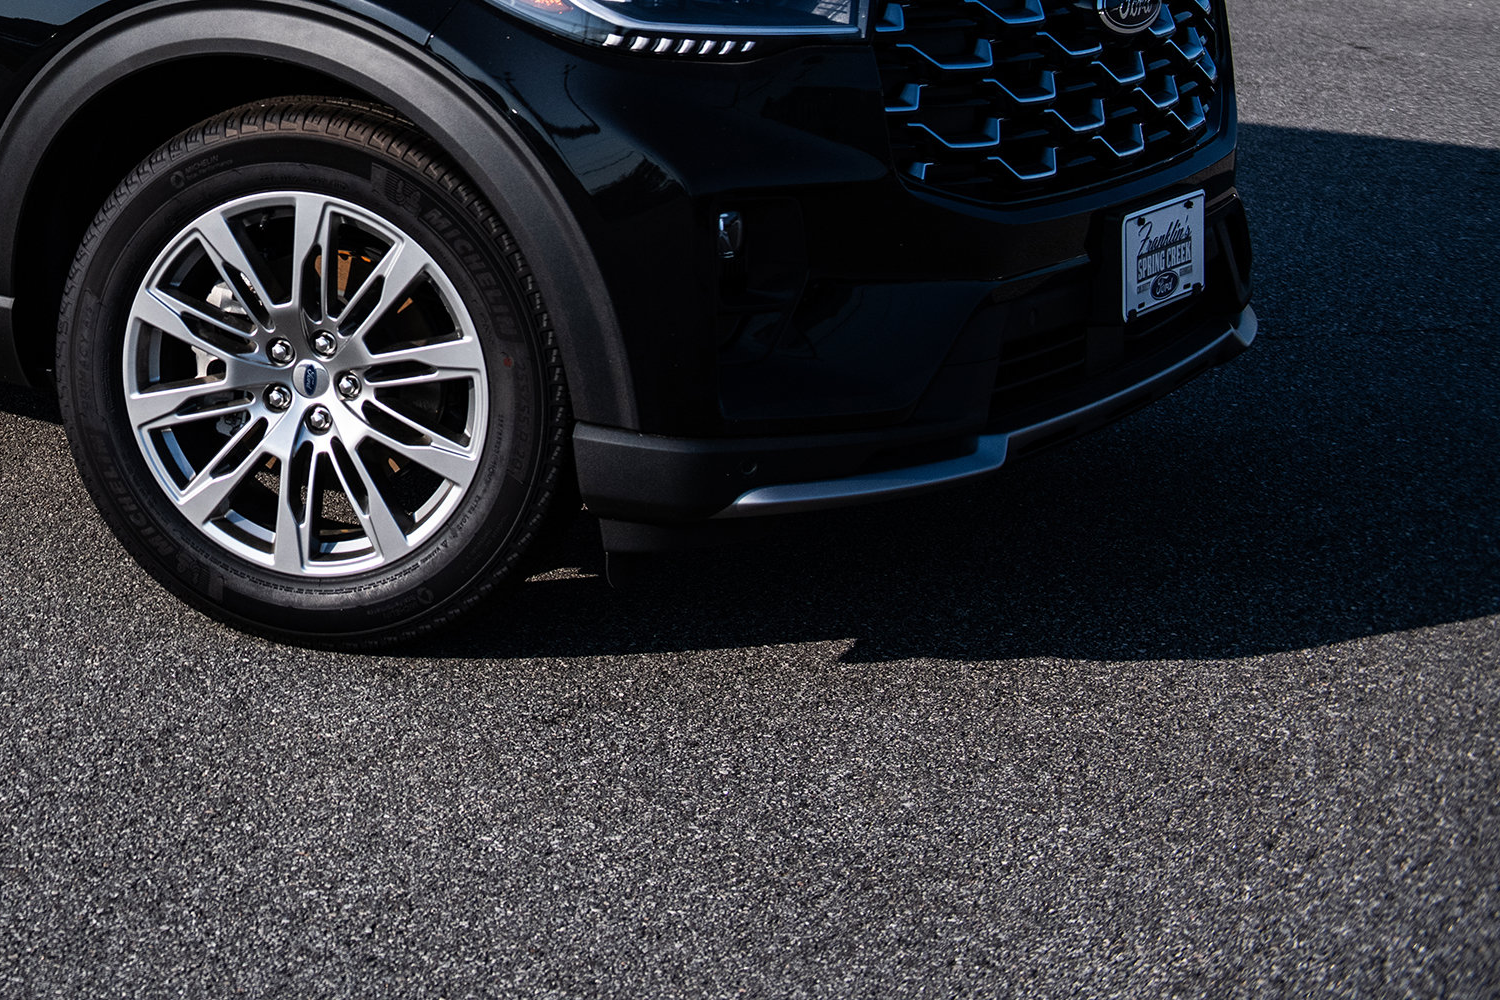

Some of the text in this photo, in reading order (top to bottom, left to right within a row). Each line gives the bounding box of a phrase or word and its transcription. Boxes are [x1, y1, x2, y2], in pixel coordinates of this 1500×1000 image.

[1137, 214, 1193, 256] Franklin's
[424, 208, 518, 335] MICHELIN
[1137, 241, 1192, 281] SPRING CREEK
[1155, 275, 1174, 296] Ford
[90, 434, 174, 557] MICHELIN
